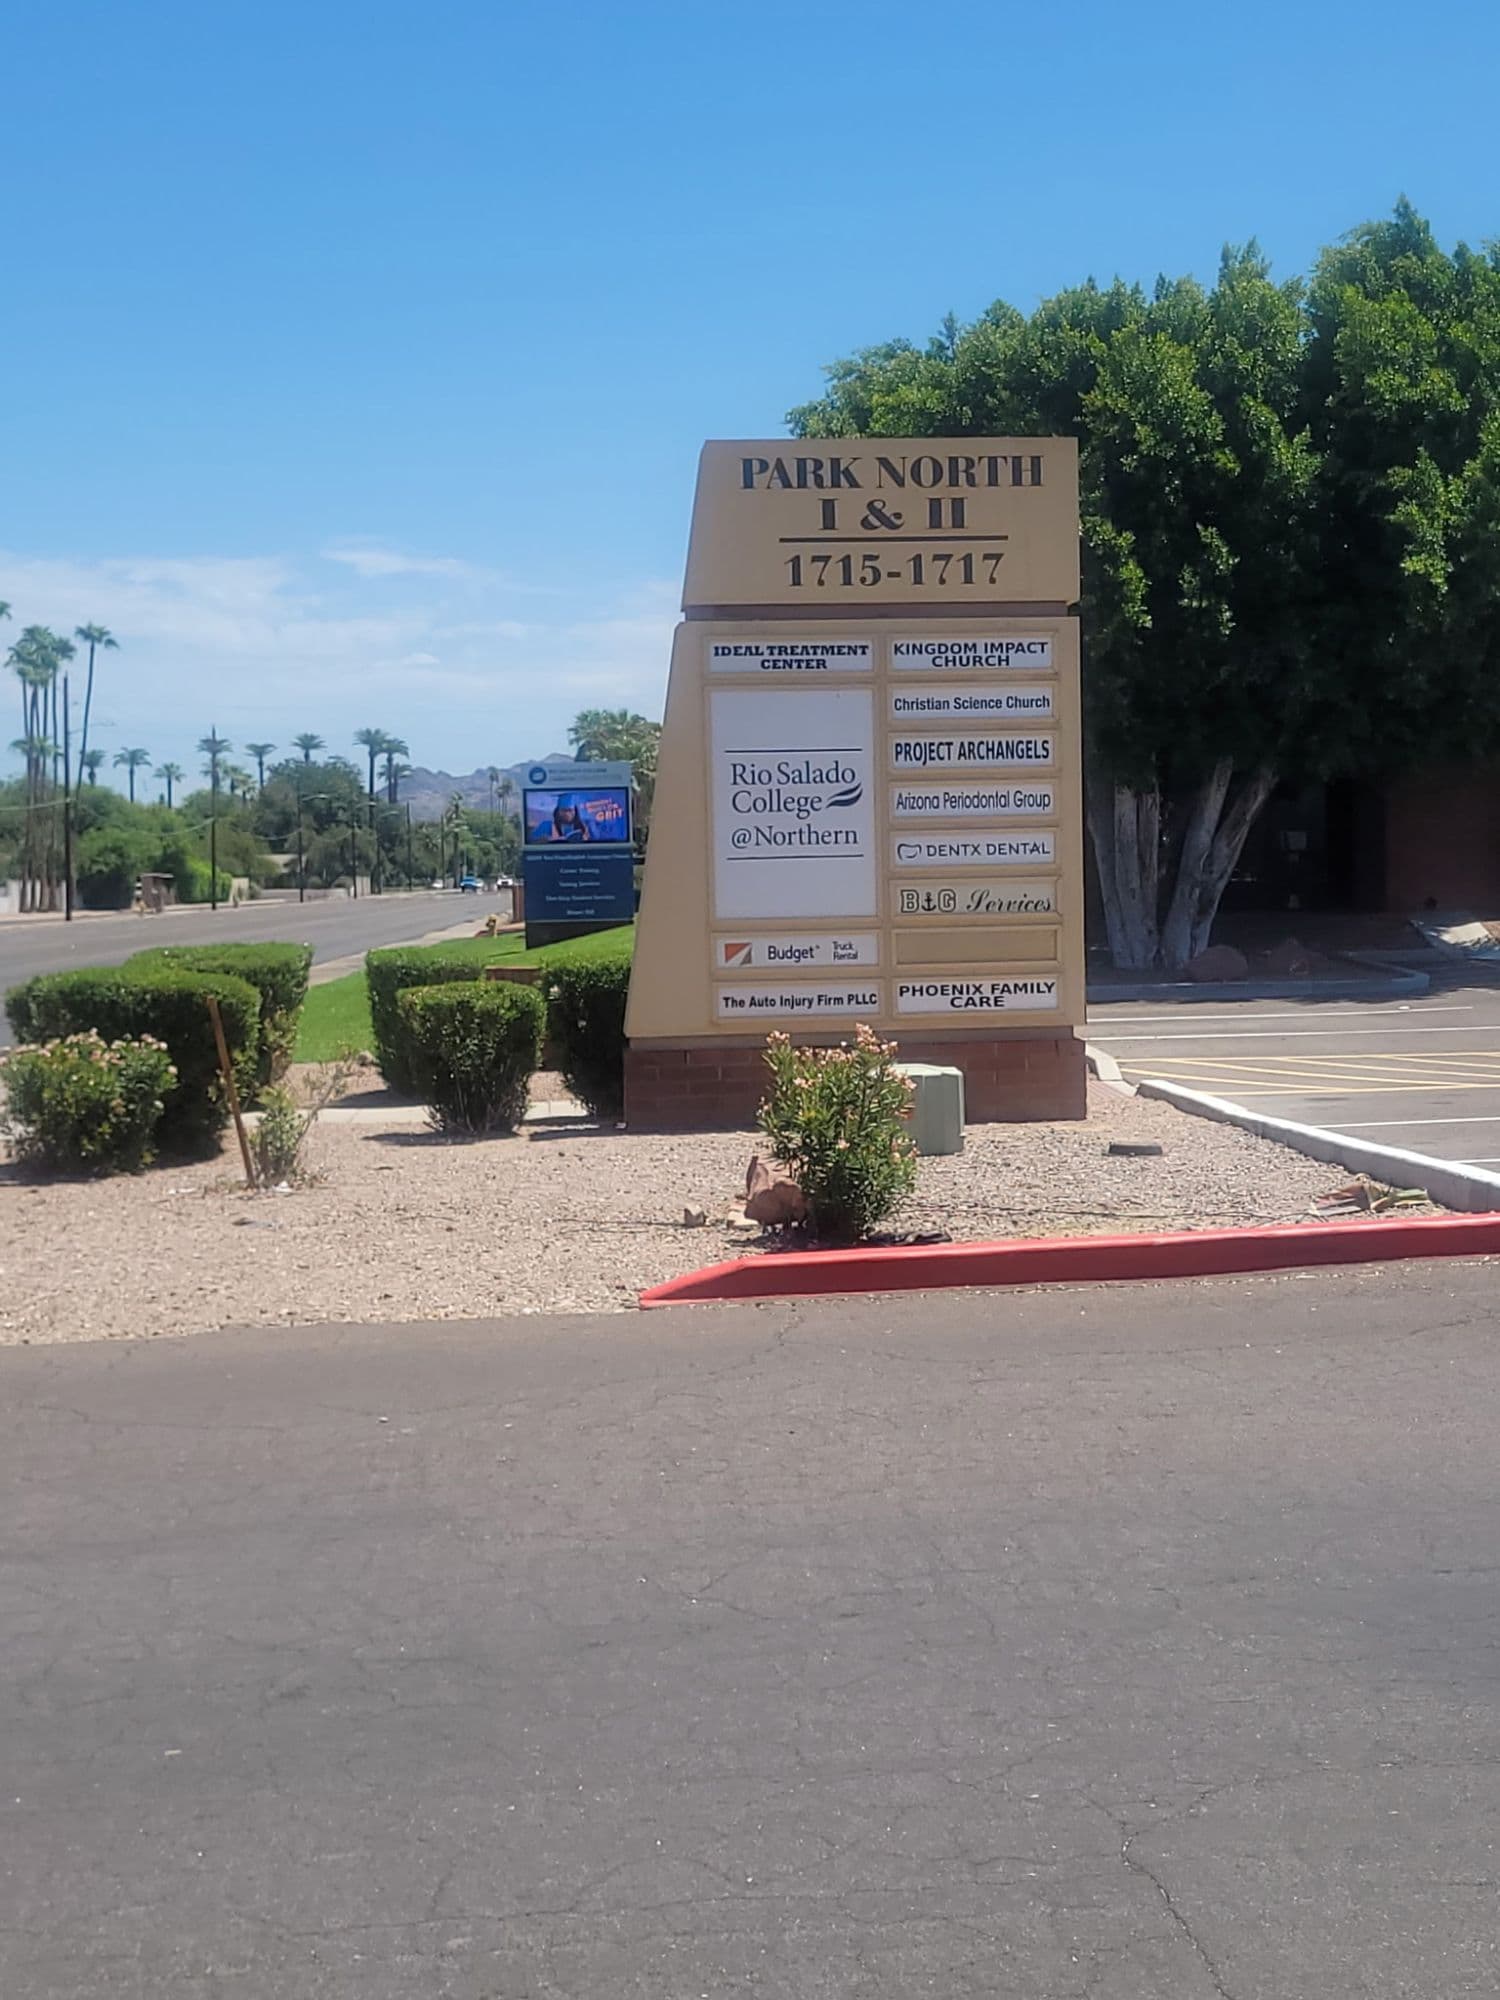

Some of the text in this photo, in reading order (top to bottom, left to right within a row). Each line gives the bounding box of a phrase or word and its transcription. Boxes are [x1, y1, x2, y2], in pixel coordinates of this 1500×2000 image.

[740, 454, 1044, 489] PARK NORTH
[818, 497, 967, 531] I & II
[784, 552, 1004, 587] 1715-1717
[713, 645, 869, 656] IDEAL TREATMENT
[894, 641, 1048, 655] KINGDOM IMPACT
[760, 658, 827, 670] CENTER
[931, 655, 1010, 667] CHURCH
[894, 695, 1050, 711] Christian Science Church
[895, 739, 1050, 766] PROJECT ARCHANGELS
[730, 760, 856, 786] Rio Salado
[732, 788, 823, 820] College
[896, 790, 1051, 811] Arizona Periodontal Group
[731, 823, 858, 850] @Northern
[926, 842, 1051, 857] DENTX DENTAL
[966, 888, 1051, 912] Services
[768, 945, 815, 963] Budget
[832, 941, 854, 950] Truck
[833, 951, 858, 961] Rental
[899, 982, 1056, 997] PHOENIX FAMILY
[723, 993, 878, 1010] The Auto Injury Firm PLLC
[950, 996, 1005, 1008] CARE
